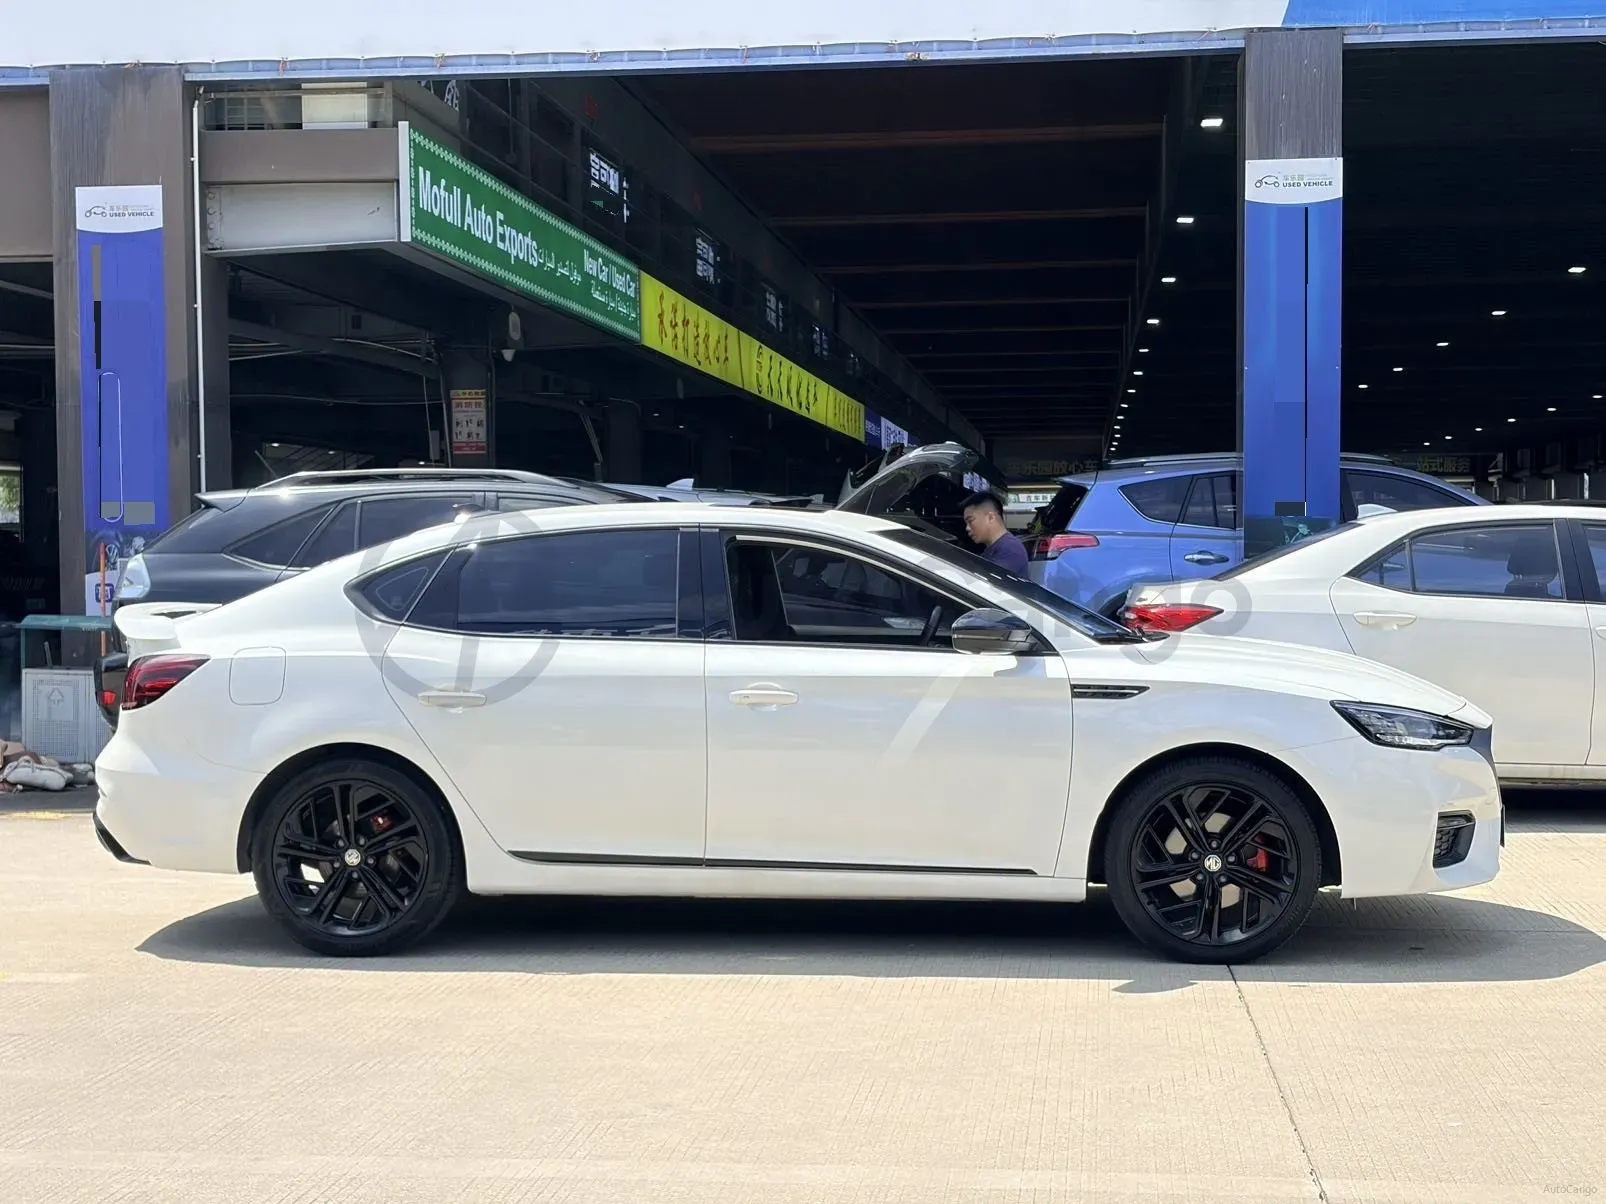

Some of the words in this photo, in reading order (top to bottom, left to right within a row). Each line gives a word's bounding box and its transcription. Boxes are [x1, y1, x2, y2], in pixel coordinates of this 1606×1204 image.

[418, 166, 462, 228] Mofull
[464, 194, 494, 244] Auto
[496, 210, 538, 268] Exports
[583, 249, 598, 277] New
[598, 257, 609, 283] Car
[612, 266, 626, 293] Used
[626, 274, 636, 298] Car
